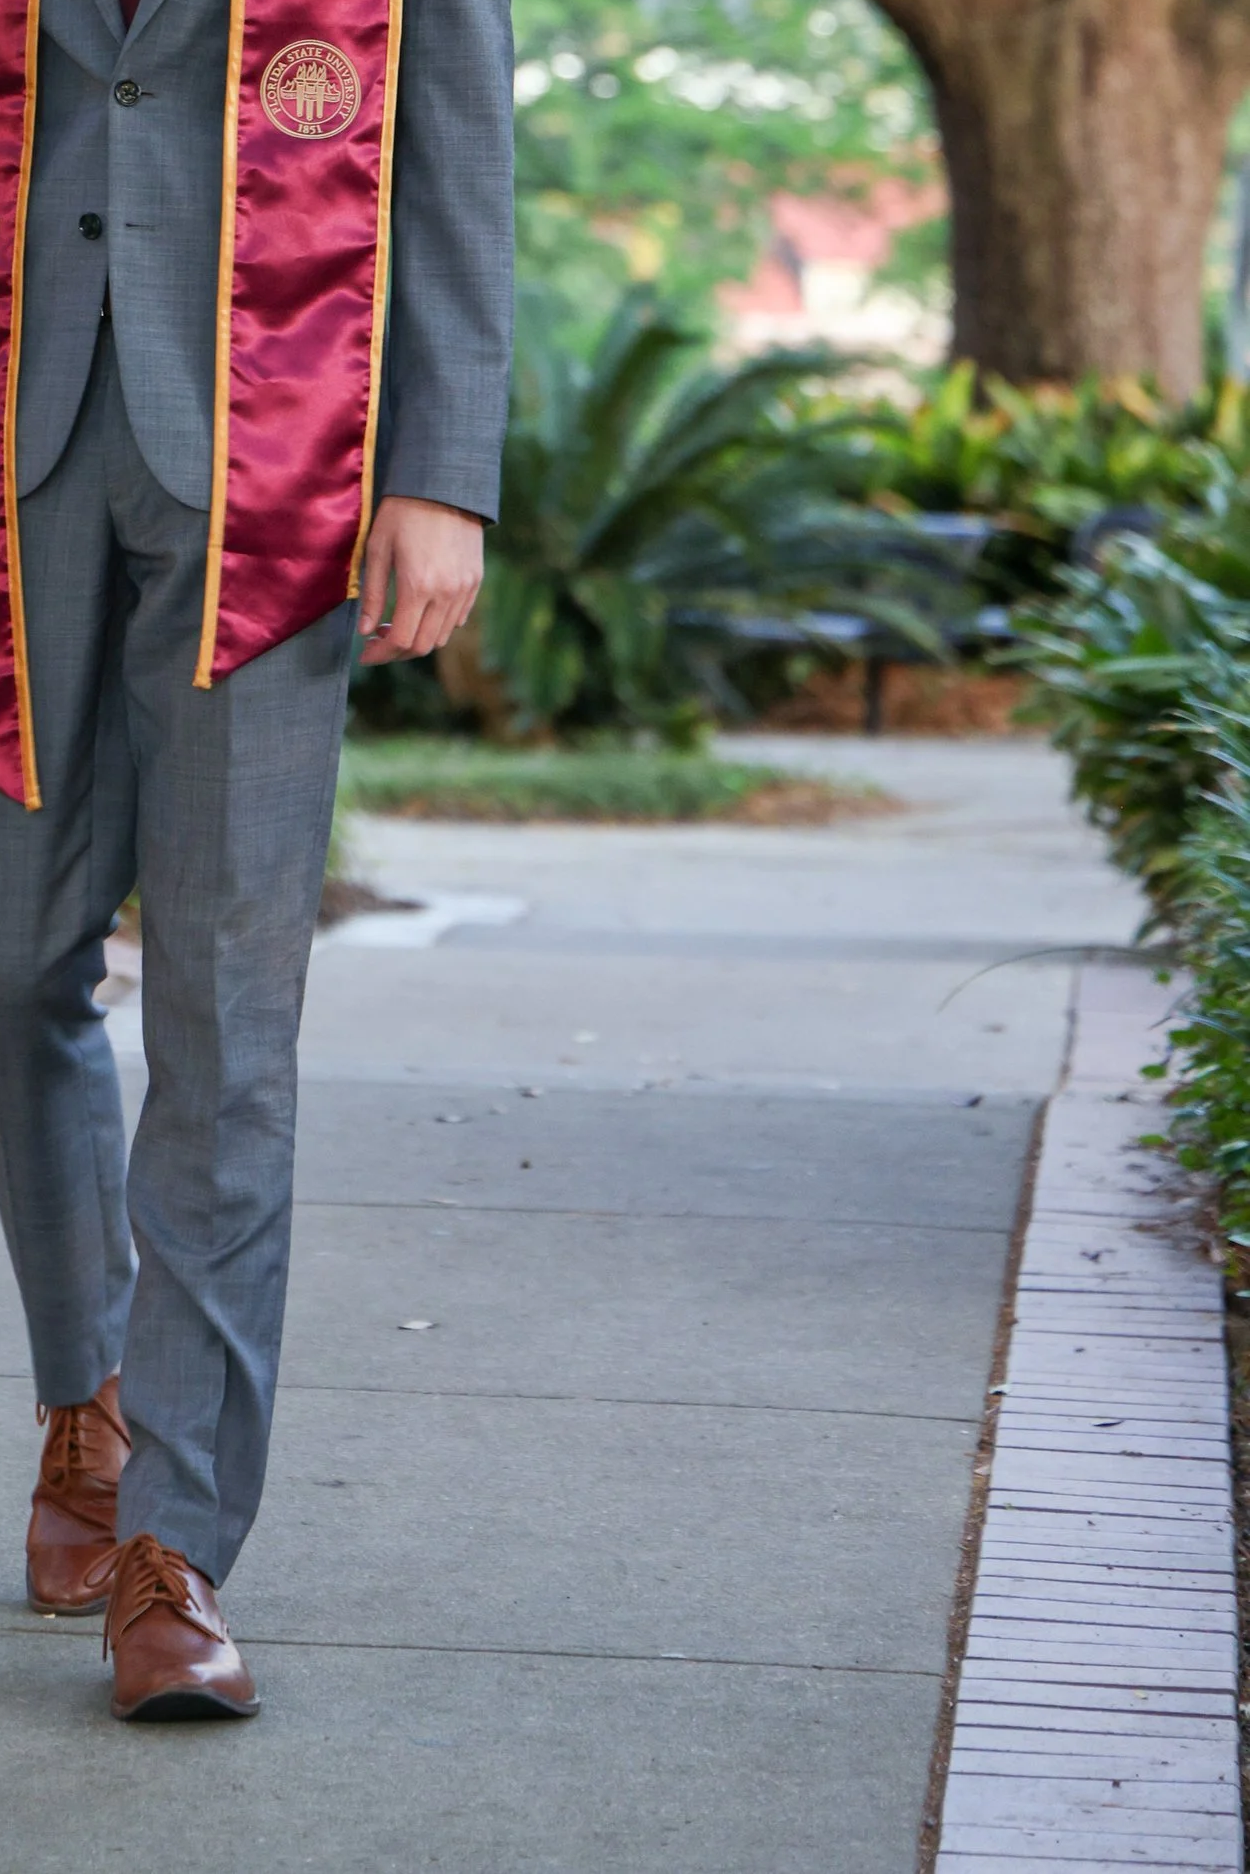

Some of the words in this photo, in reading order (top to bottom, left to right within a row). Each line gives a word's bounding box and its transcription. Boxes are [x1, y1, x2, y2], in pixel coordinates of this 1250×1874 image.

[267, 62, 287, 115] FLORIDA
[287, 47, 323, 62] STATE
[326, 52, 355, 120] UNIVERSITY
[297, 124, 323, 134] 1851
